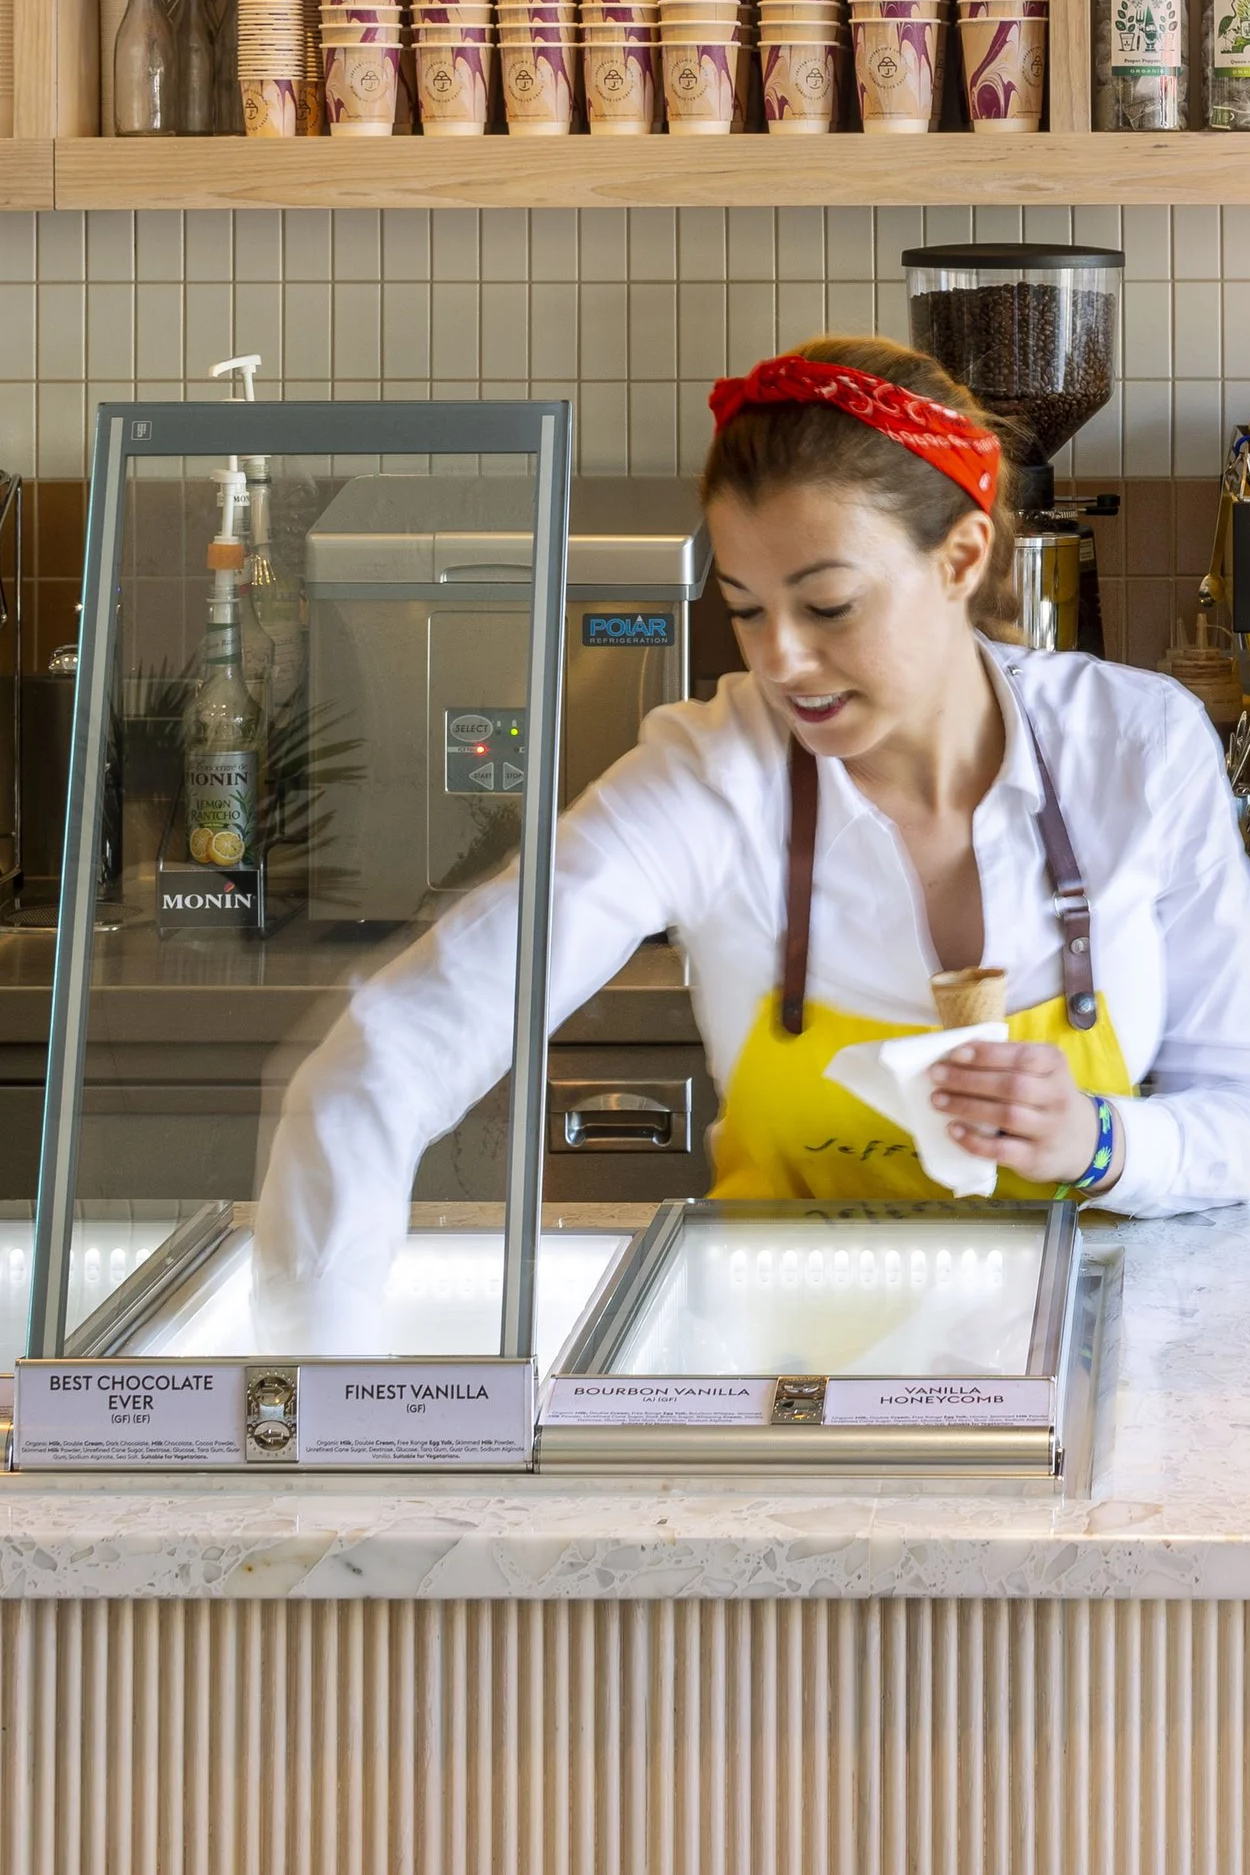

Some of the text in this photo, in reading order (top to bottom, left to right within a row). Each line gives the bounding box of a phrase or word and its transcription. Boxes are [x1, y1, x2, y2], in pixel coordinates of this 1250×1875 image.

[590, 615, 666, 637] POLAR
[455, 725, 489, 734] SELECT
[197, 799, 231, 810] LEMON
[191, 810, 240, 822] RANTCHO
[162, 893, 253, 910] MONIN
[49, 1375, 214, 1391] BEST CHOCOLATE
[345, 1384, 489, 1400] FINEST VANILLA
[574, 1387, 750, 1396] BOURBON VANILLA
[108, 1395, 154, 1411] EVER
[880, 1395, 1004, 1404] HONEYCOMB
[406, 1403, 426, 1415] (GF)
[111, 1413, 150, 1425] (GF) (EF)
